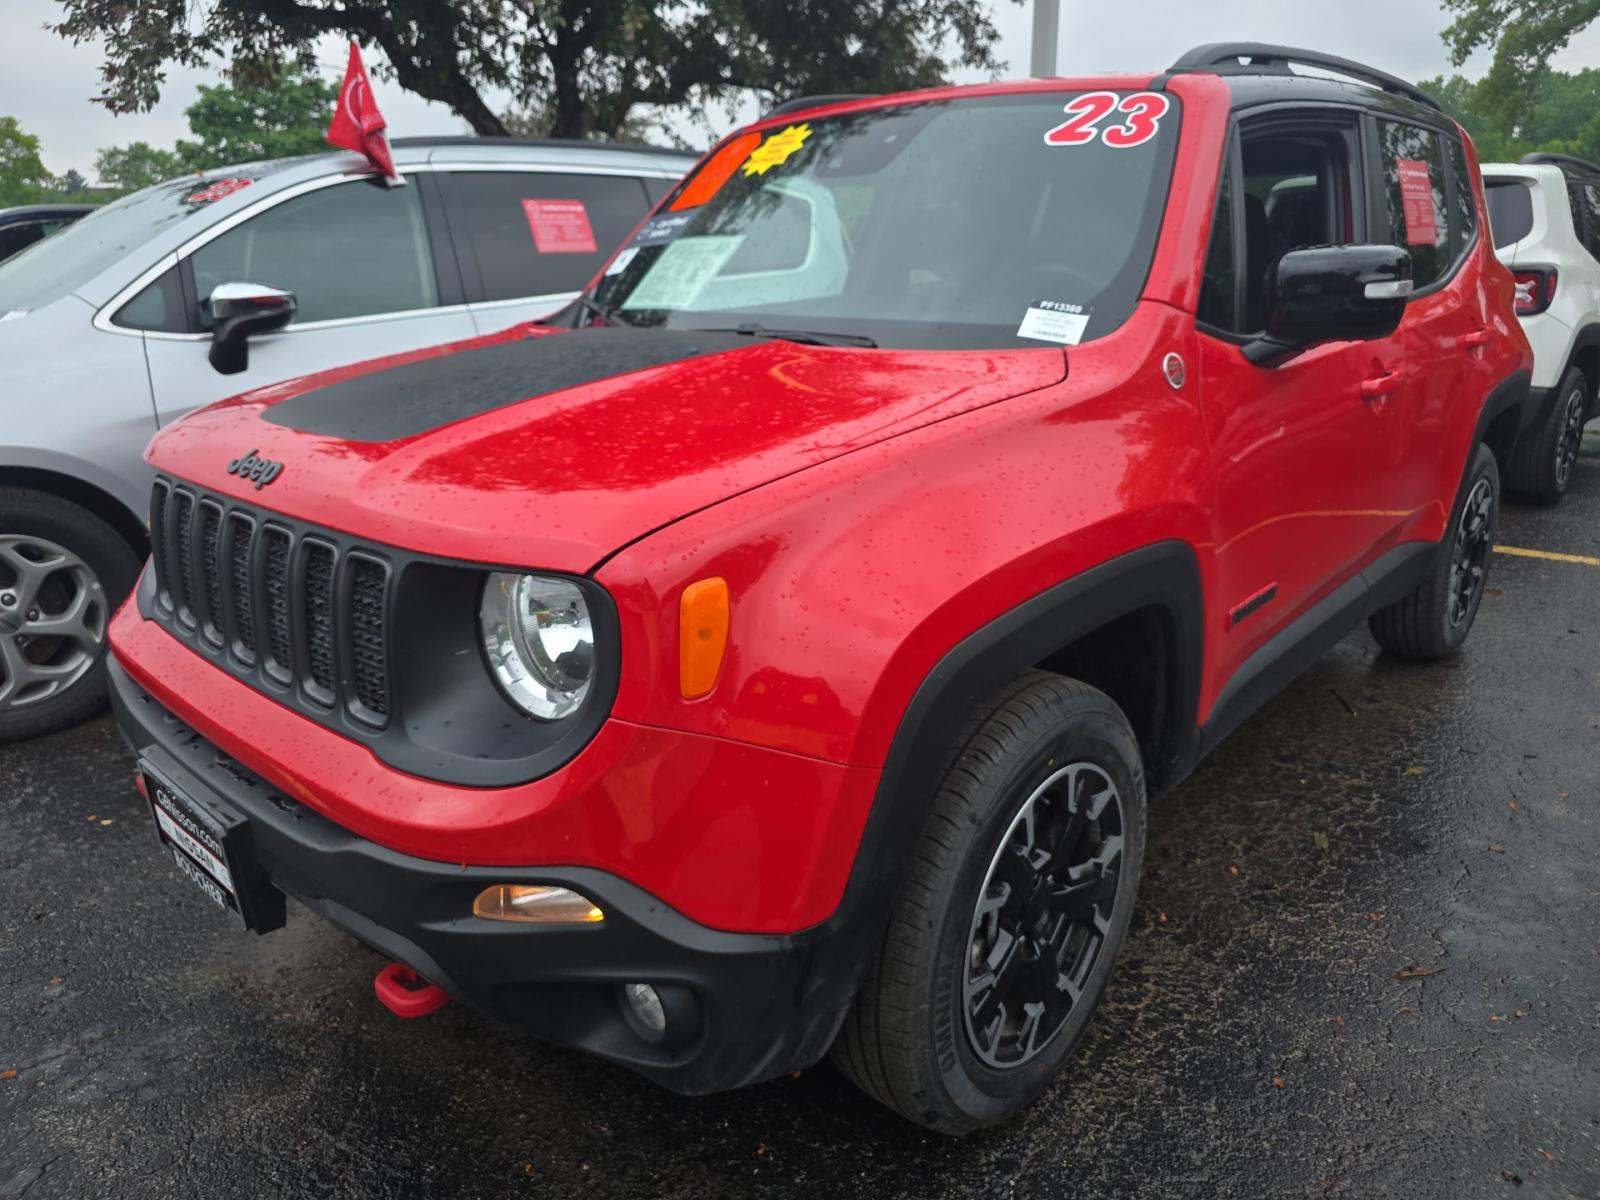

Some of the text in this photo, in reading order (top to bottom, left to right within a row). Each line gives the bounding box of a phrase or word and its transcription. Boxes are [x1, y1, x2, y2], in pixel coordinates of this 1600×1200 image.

[1043, 91, 1170, 148] 23
[227, 448, 284, 491] Jeep
[174, 827, 216, 873] NISSAN
